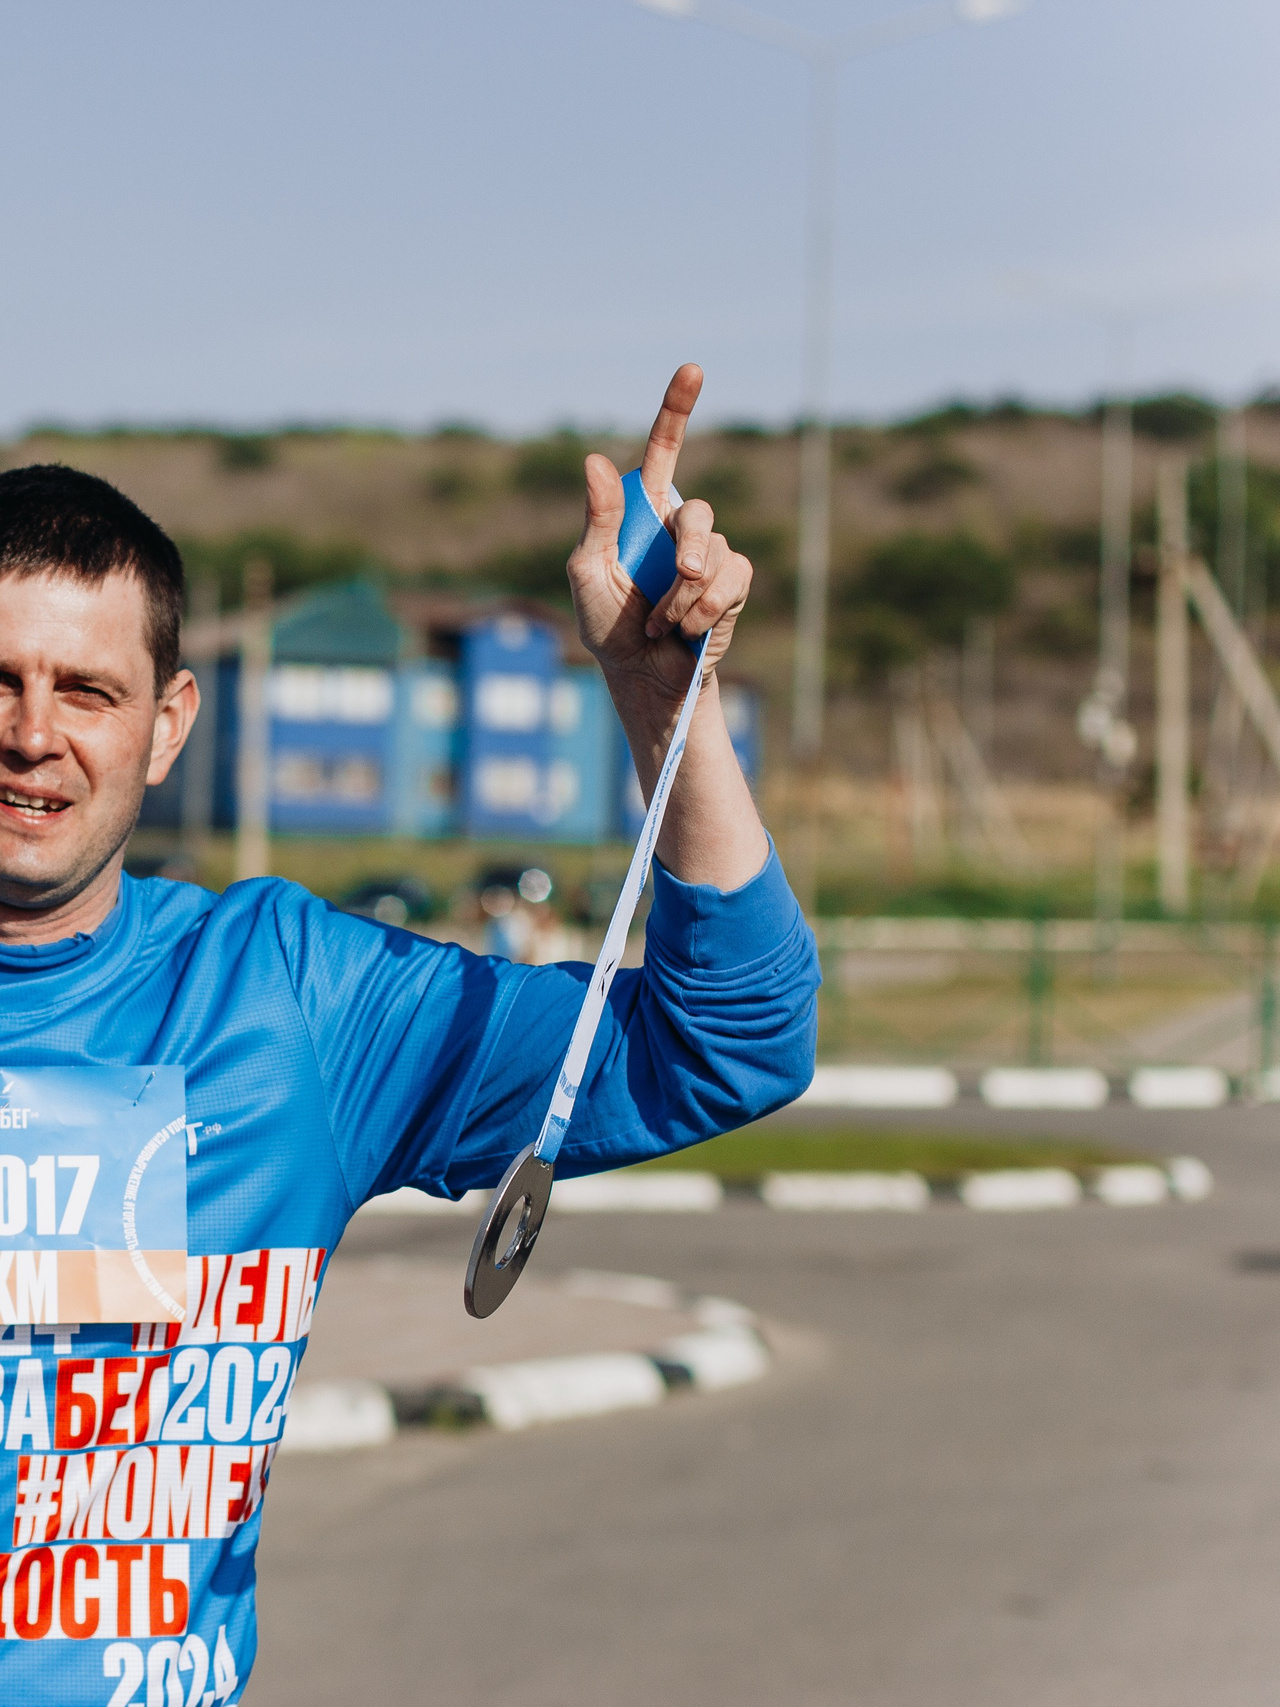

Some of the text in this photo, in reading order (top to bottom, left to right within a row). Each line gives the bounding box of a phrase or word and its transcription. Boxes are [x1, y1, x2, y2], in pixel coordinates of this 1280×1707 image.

[122, 1201, 140, 1251] #ГОРДОСТЬ
[131, 1247, 327, 1352] ЦЕЛЬ
[103, 1624, 238, 1707] 2024
